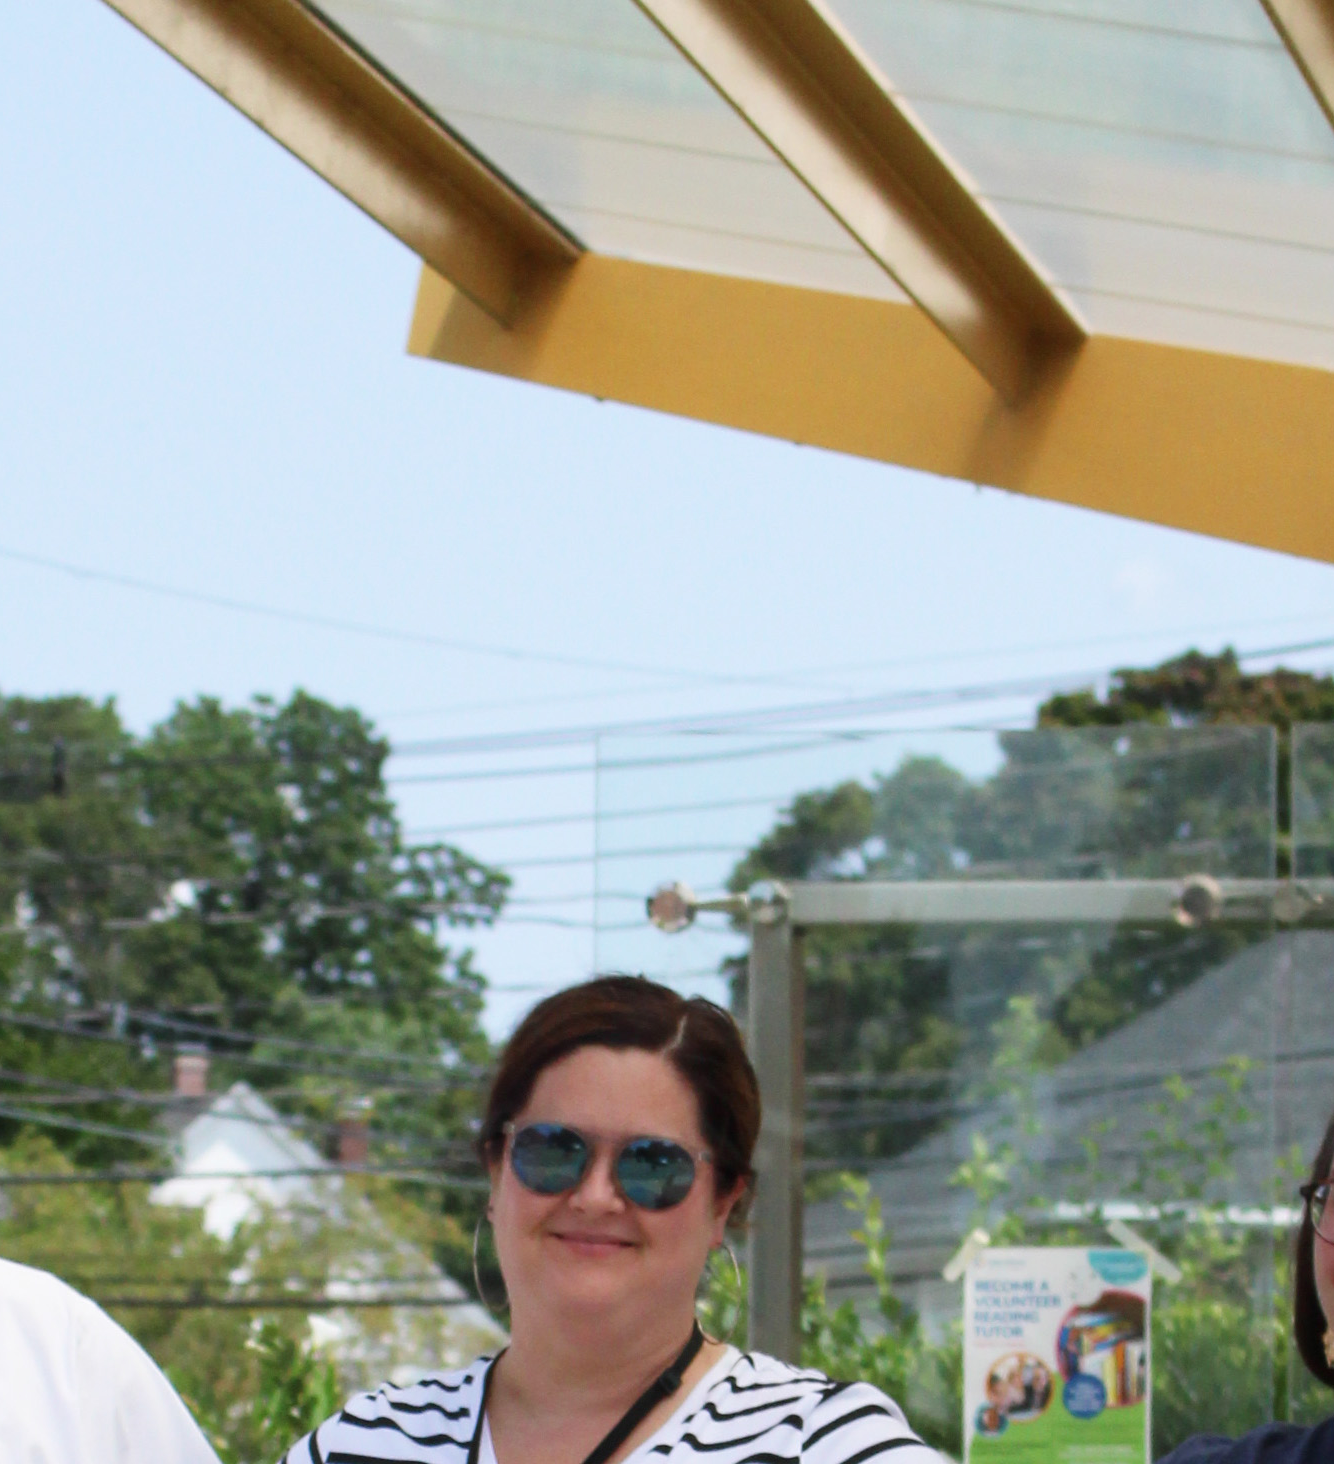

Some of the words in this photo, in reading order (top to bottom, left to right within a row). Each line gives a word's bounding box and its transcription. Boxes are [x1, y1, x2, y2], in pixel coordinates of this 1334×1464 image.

[975, 1280, 1034, 1291] BECOME
[1039, 1281, 1049, 1290] A
[975, 1294, 1062, 1308] VOLUNTEER
[974, 1311, 1040, 1323] READING
[975, 1326, 1024, 1337] TUTOR
